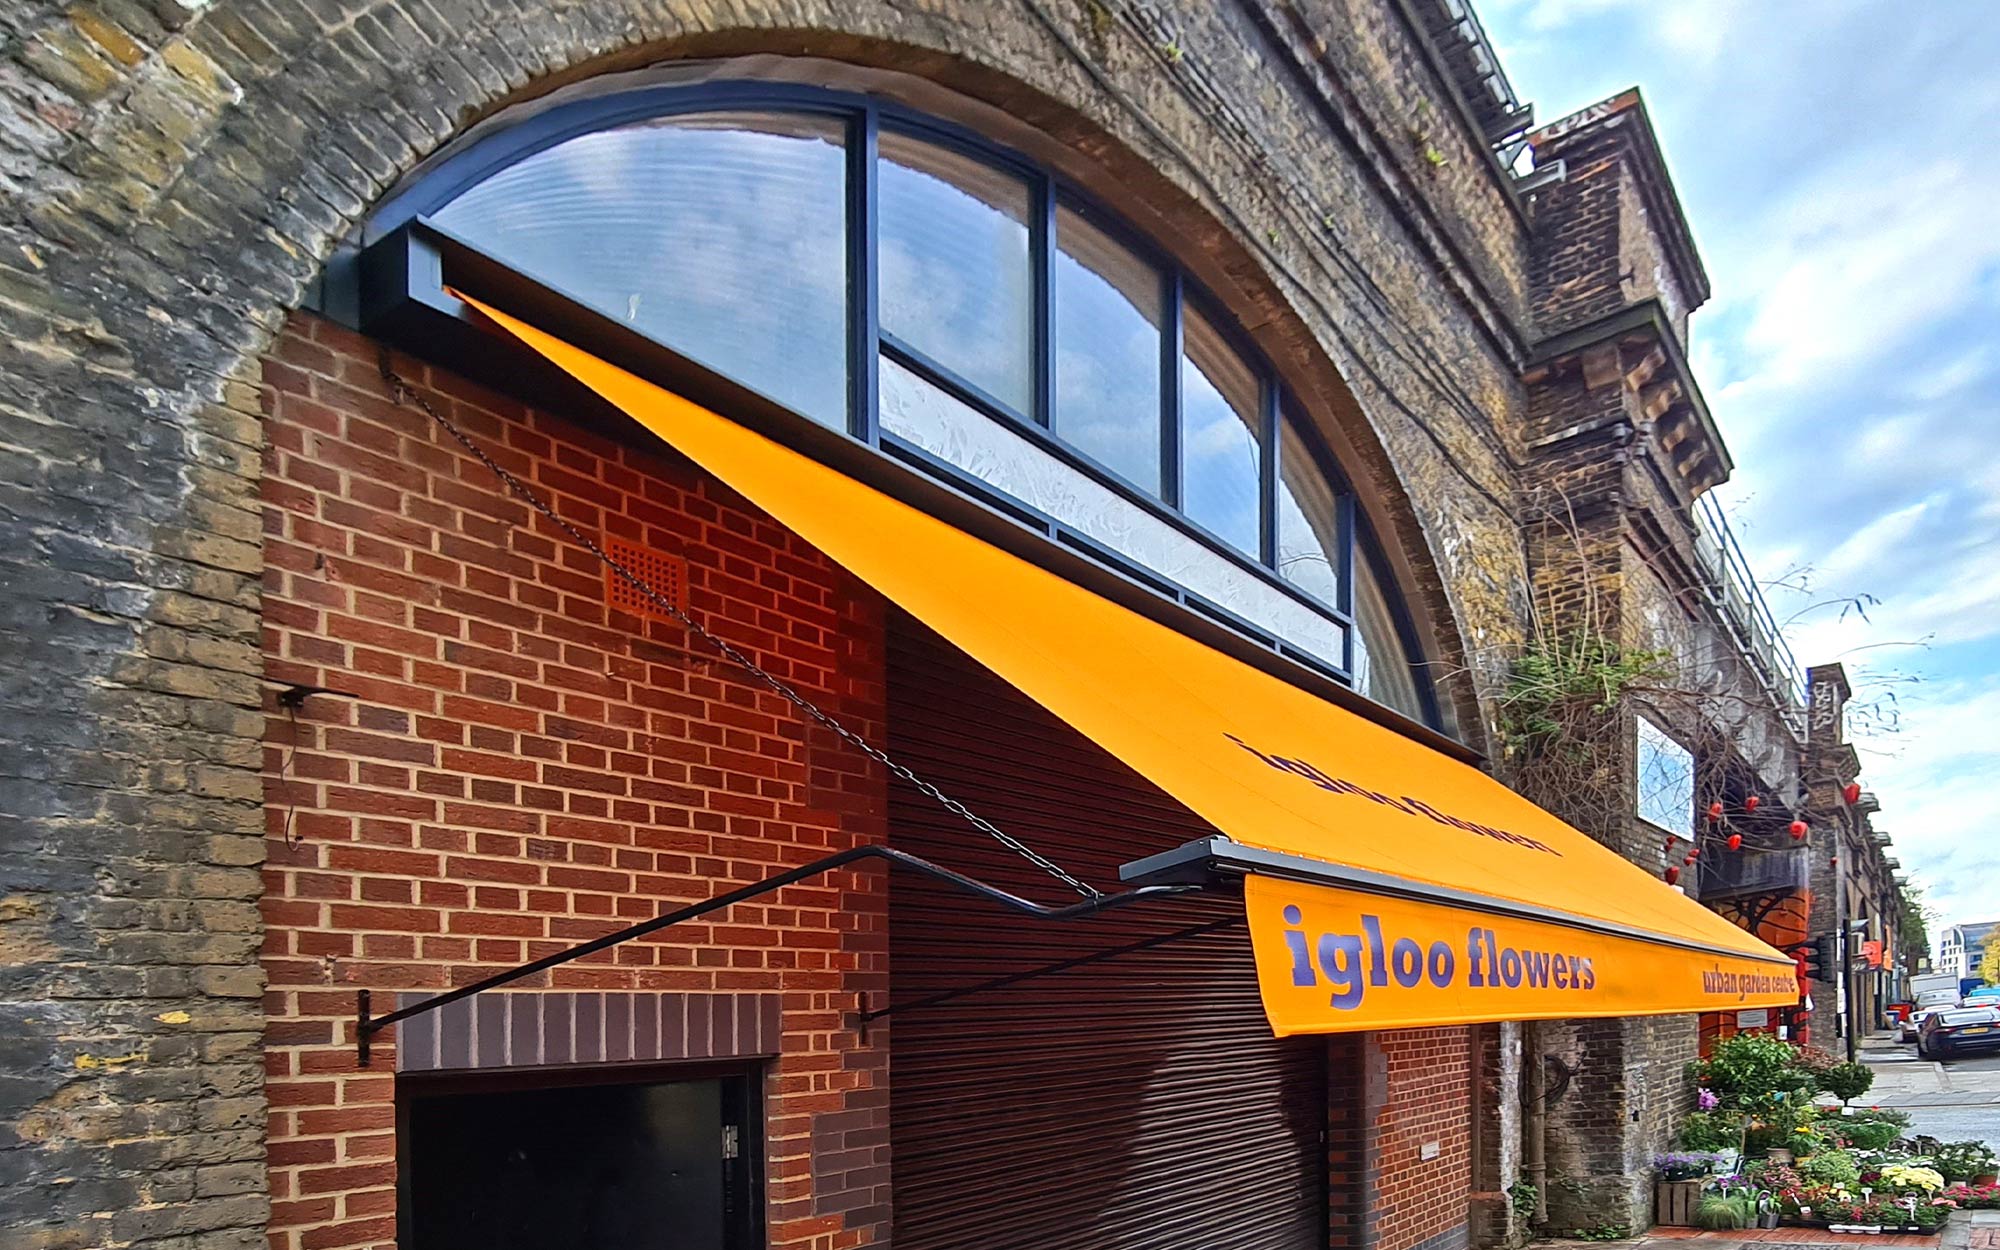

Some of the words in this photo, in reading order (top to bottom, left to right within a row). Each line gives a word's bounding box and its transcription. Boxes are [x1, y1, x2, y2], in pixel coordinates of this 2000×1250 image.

[1222, 732, 1417, 816] igloo
[1282, 904, 1454, 1010] igloo
[1467, 926, 1594, 990] flowers
[1702, 963, 1738, 993] urban
[1738, 968, 1771, 1001] garden
[1772, 973, 1795, 993] centre
